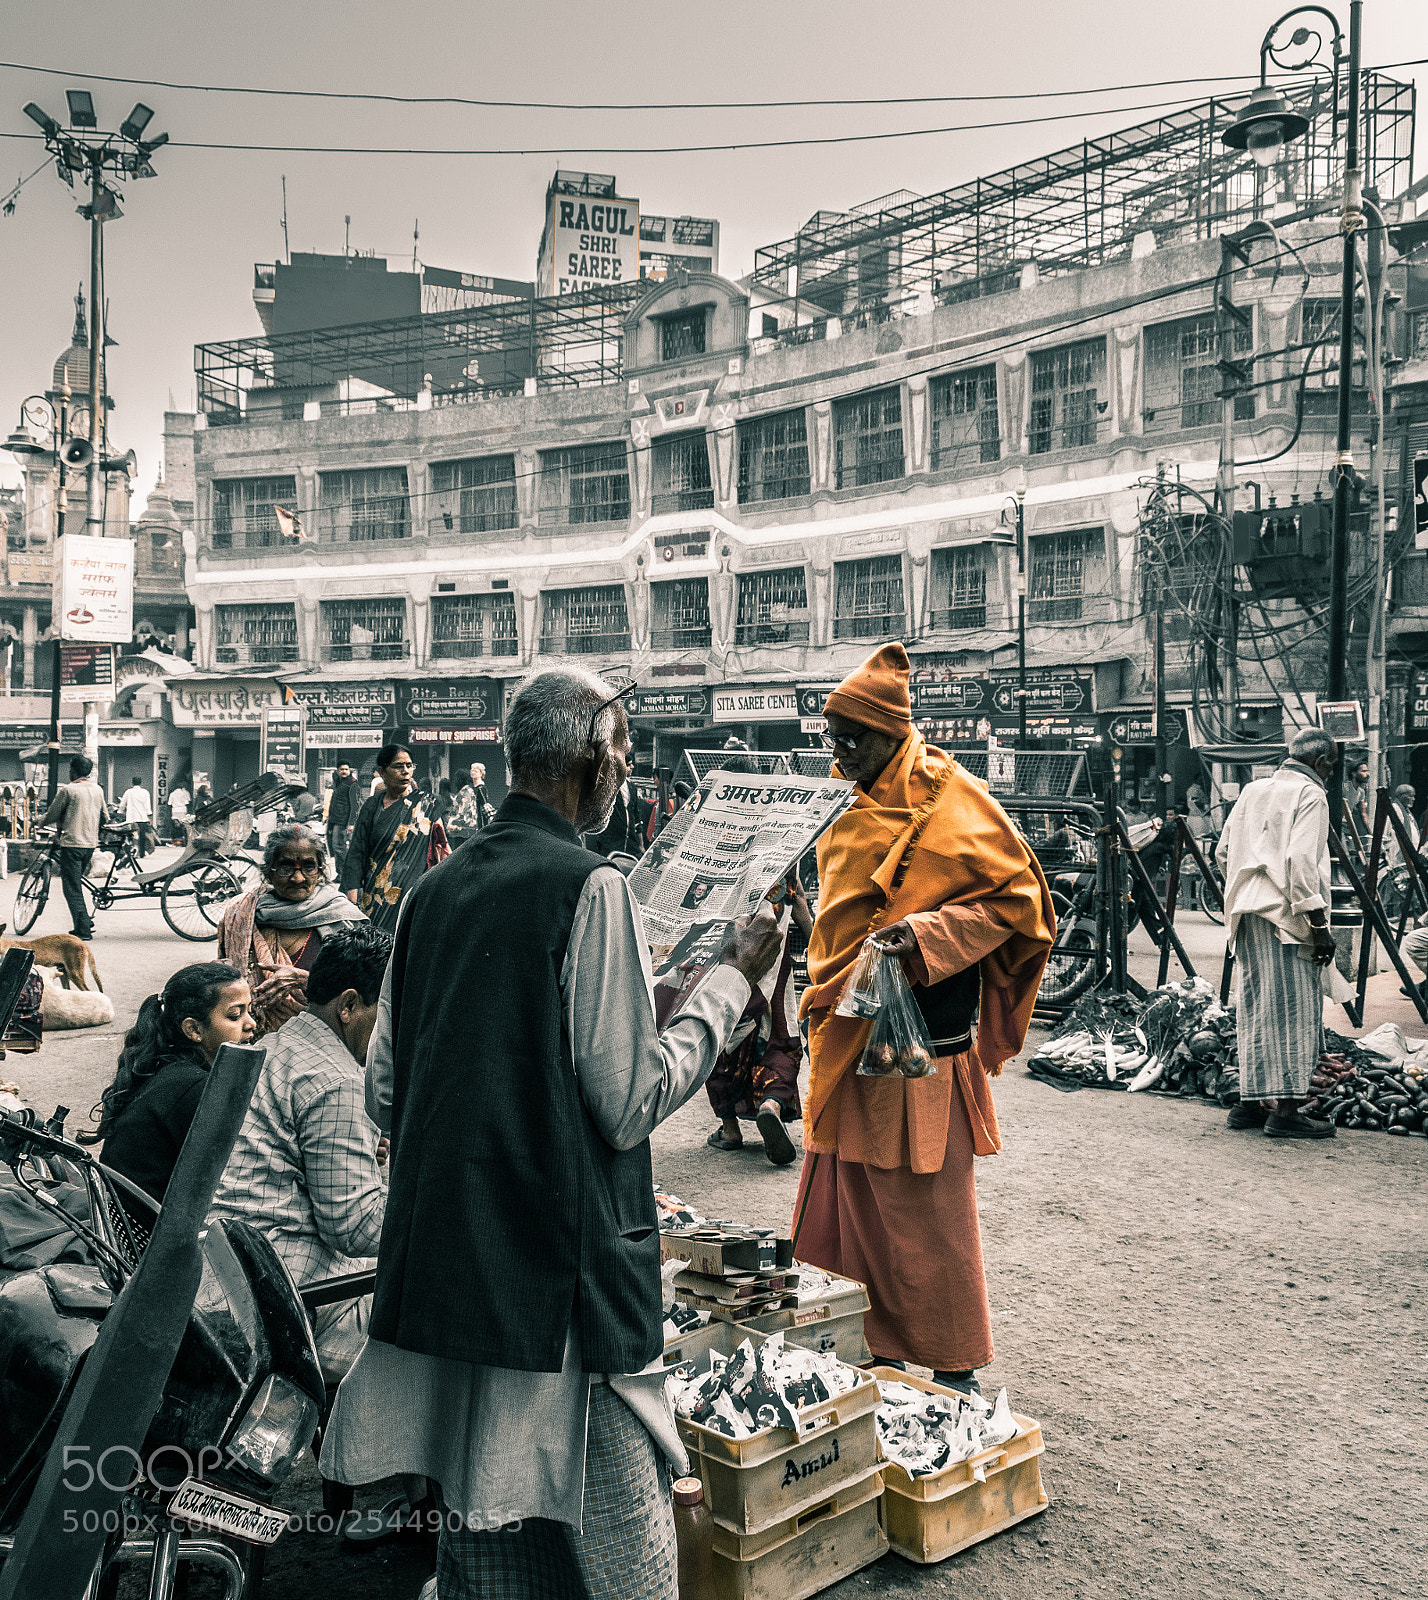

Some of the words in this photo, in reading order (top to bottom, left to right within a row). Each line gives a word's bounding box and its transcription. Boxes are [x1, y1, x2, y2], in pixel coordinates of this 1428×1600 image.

[559, 200, 635, 236] RAGUL
[579, 234, 617, 254] SHRI
[568, 253, 622, 281] SAREE
[411, 687, 438, 698] Rita
[717, 697, 735, 711] SITA
[738, 696, 765, 710] SAREE
[767, 694, 797, 709] CENTE
[415, 731, 438, 741] BOOK
[439, 731, 453, 741] MY
[453, 731, 495, 741] SURPRISE
[716, 784, 764, 804] अमर
[761, 787, 817, 805] उजाला
[781, 1438, 840, 1491] Amul
